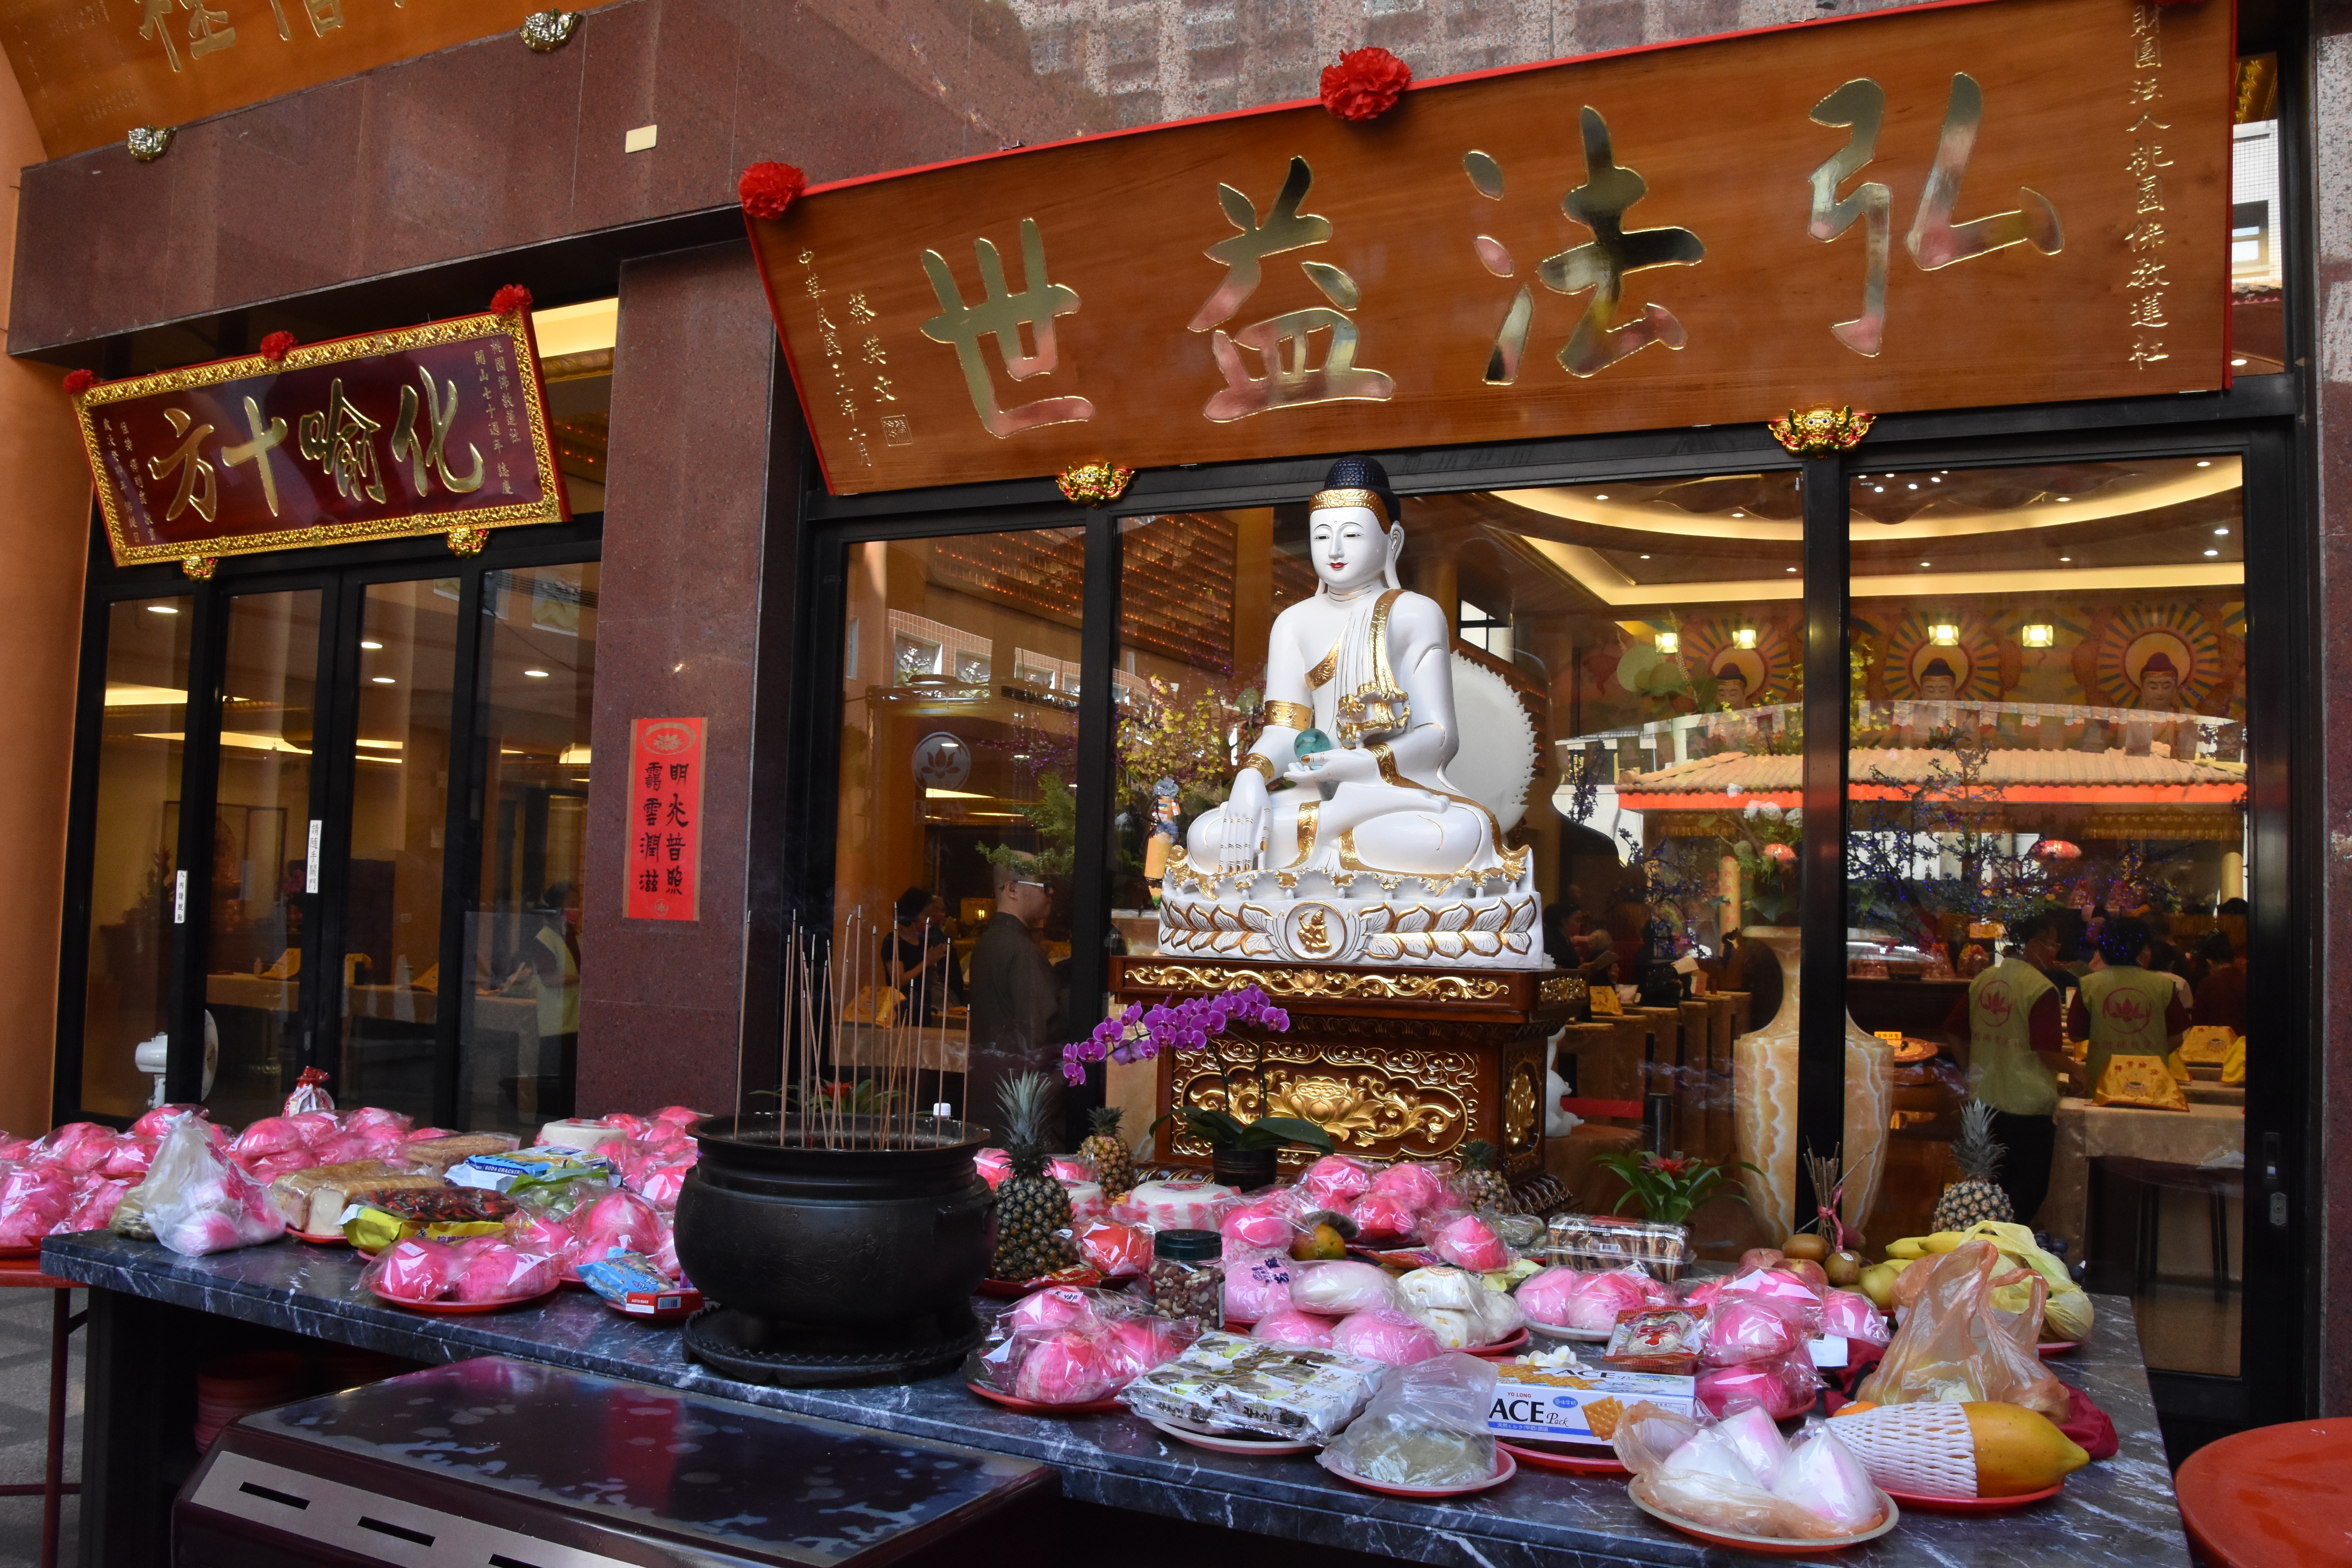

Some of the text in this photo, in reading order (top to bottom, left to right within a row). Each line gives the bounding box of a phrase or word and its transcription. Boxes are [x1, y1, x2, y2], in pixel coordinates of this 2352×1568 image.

[2124, 5, 2174, 370] 財團法人桃園佛教蓮社
[919, 71, 2064, 439] 弘法益世
[490, 339, 521, 443] 桃園佛教蓮社
[147, 365, 485, 523] 化喻十方
[309, 823, 320, 890] 請隨手關門
[1488, 1397, 1569, 1427] ACE Pack
[1555, 1369, 1616, 1379] ACE
